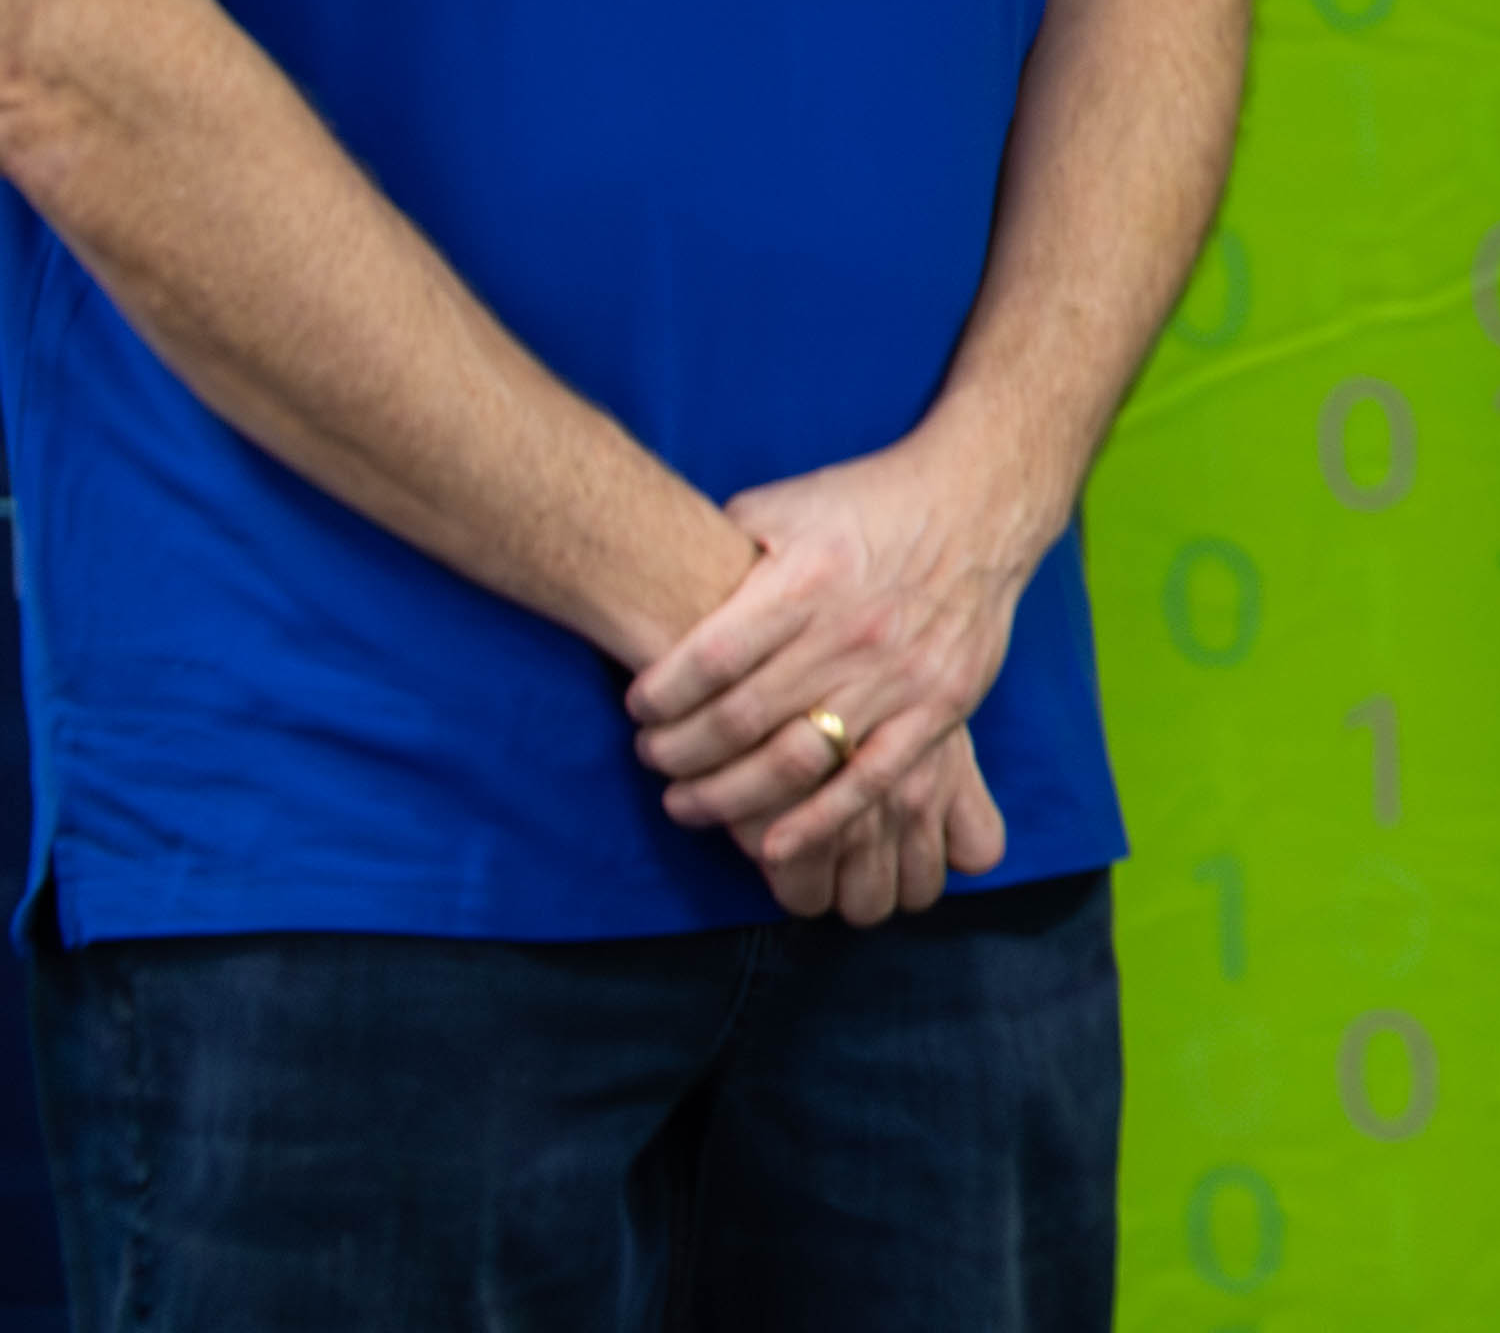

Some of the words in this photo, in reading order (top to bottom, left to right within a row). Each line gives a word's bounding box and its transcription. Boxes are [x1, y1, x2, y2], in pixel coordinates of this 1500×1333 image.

[1316, 374, 1418, 514] 0
[1161, 537, 1263, 669] 0
[1342, 692, 1400, 828] 1
[1192, 852, 1249, 982] 1
[1337, 1008, 1441, 1143] 0
[1185, 1163, 1286, 1296] 0
